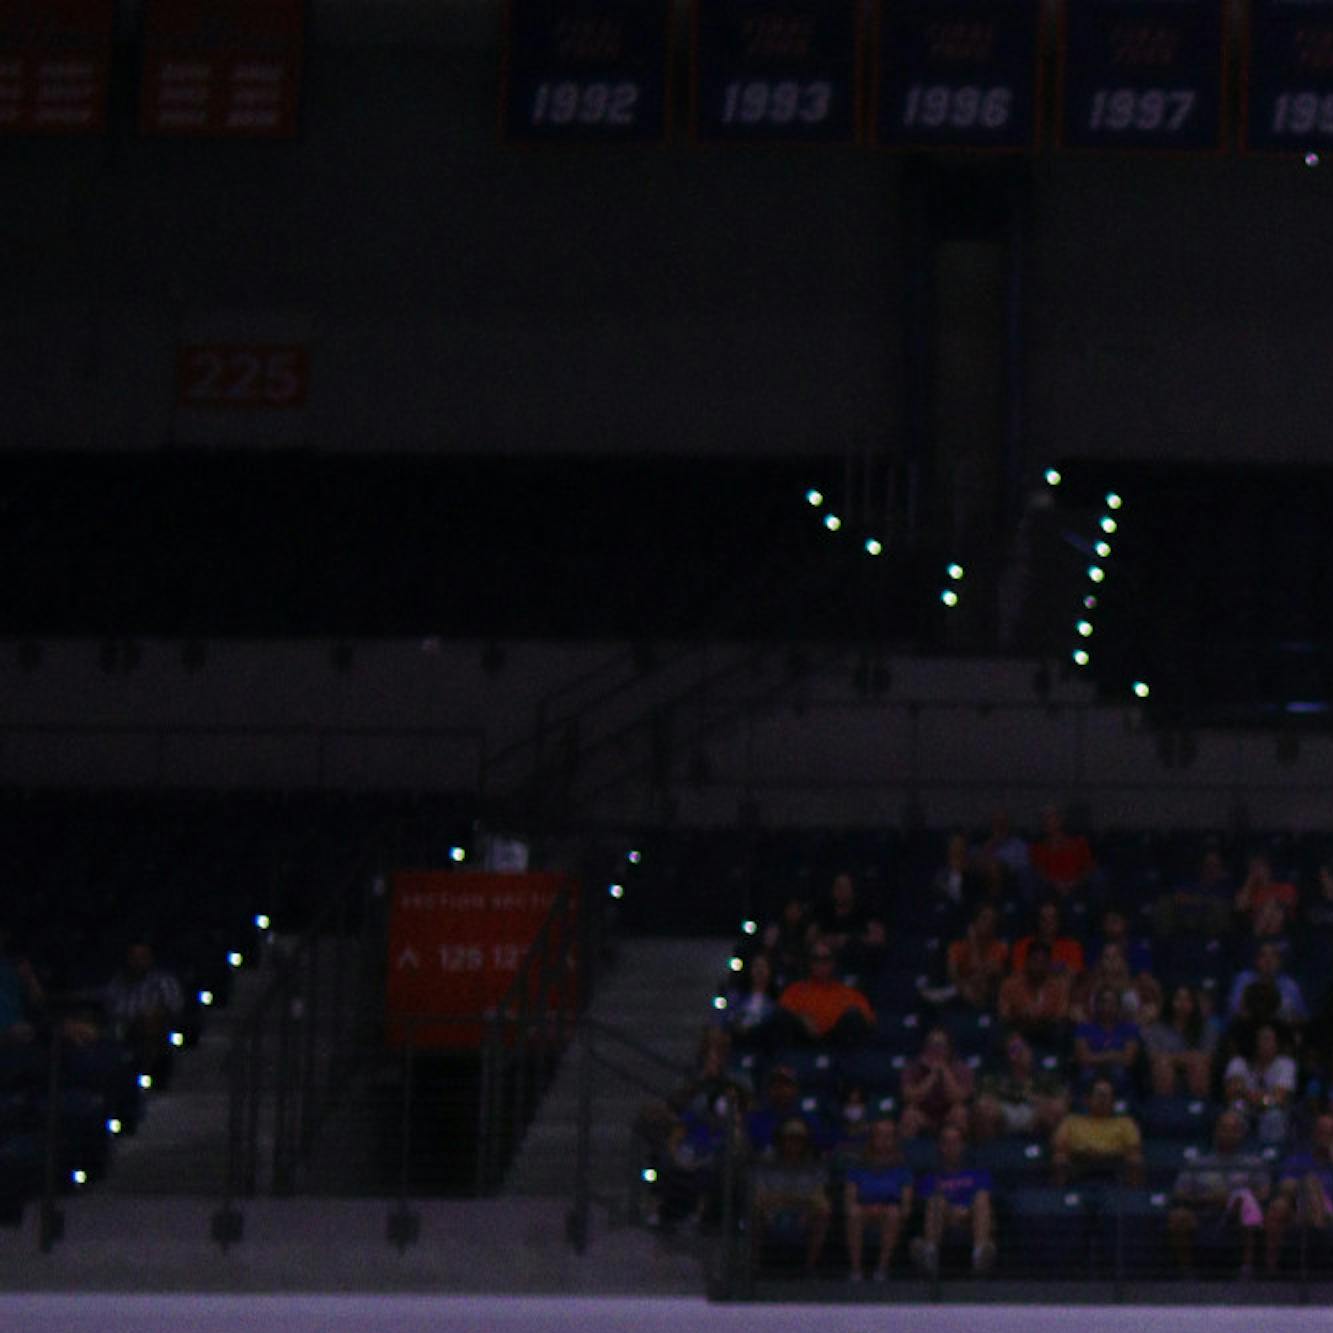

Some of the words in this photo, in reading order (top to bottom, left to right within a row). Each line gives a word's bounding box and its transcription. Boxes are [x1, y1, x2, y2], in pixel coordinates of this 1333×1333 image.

[530, 79, 639, 127] 1992
[722, 80, 833, 126] 1993
[1088, 86, 1197, 132] 1997
[189, 351, 299, 402] 225
